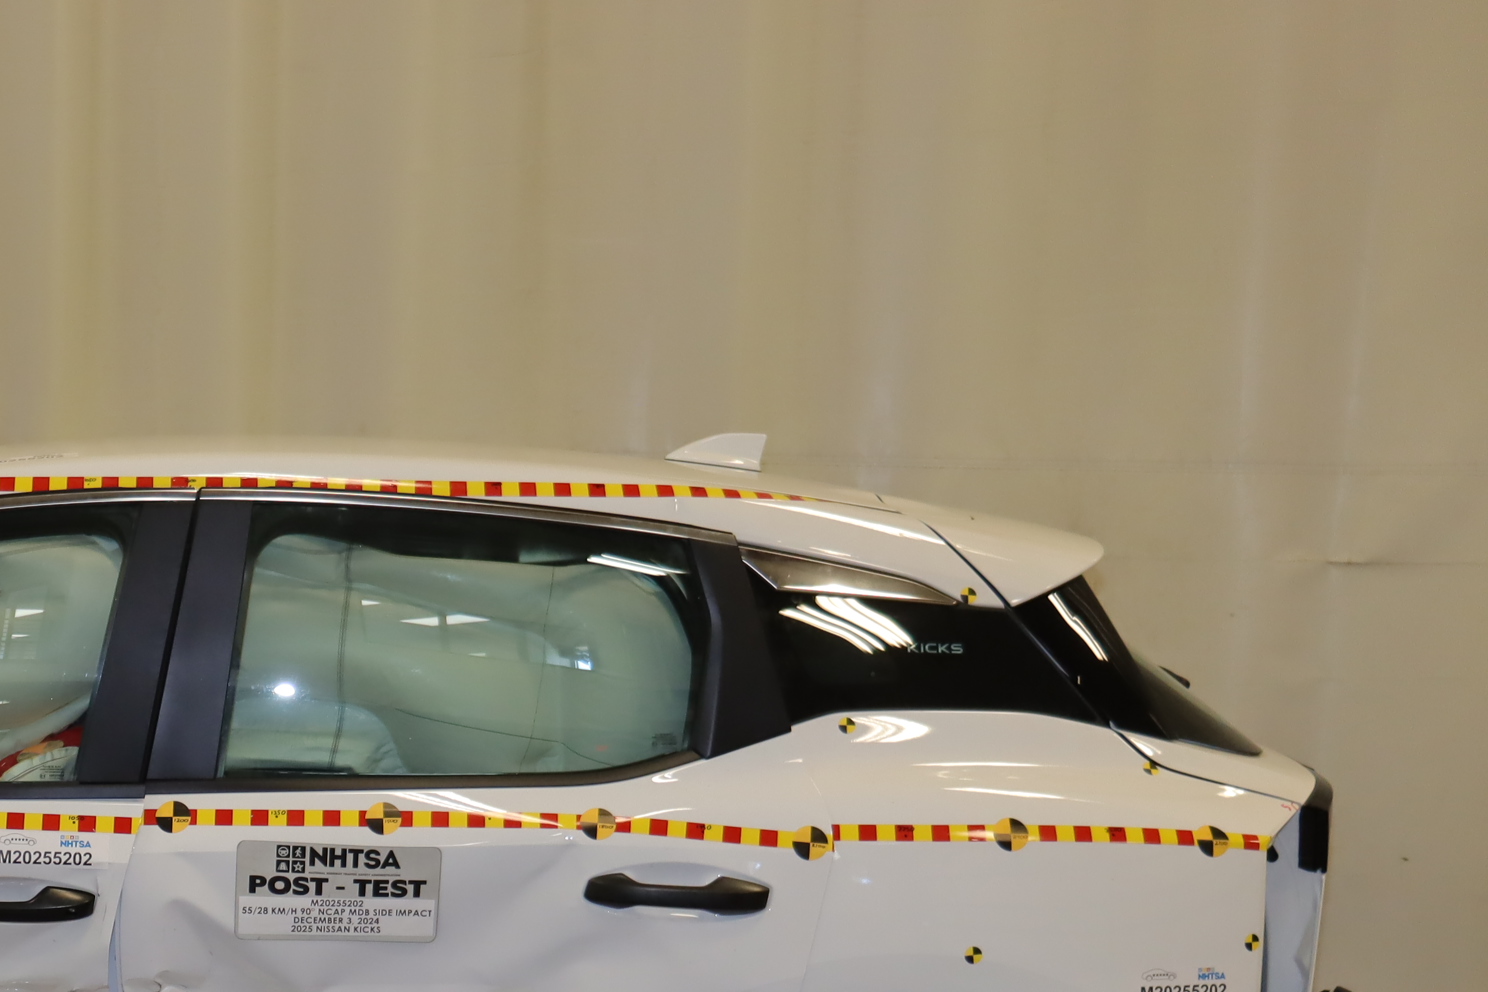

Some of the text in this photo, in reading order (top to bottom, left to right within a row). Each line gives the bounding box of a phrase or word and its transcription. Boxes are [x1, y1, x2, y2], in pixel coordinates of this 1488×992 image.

[907, 643, 963, 654] KICKS
[60, 840, 91, 848] NHTSA
[309, 846, 401, 869] NHTSA
[248, 875, 329, 896] POST
[353, 879, 427, 898] TEST
[311, 899, 364, 908] M20255202
[242, 907, 268, 916] 55/28
[271, 907, 297, 916] KM/H
[318, 908, 346, 916] NCAP
[348, 908, 370, 916] MDB
[372, 909, 392, 917] SIDE
[395, 909, 432, 918] IMPACT
[293, 917, 343, 925] DECEMBER
[358, 917, 380, 925] 2024
[291, 925, 381, 934] 2025 NISSAN KICKS
[1198, 971, 1226, 981] NHTSA
